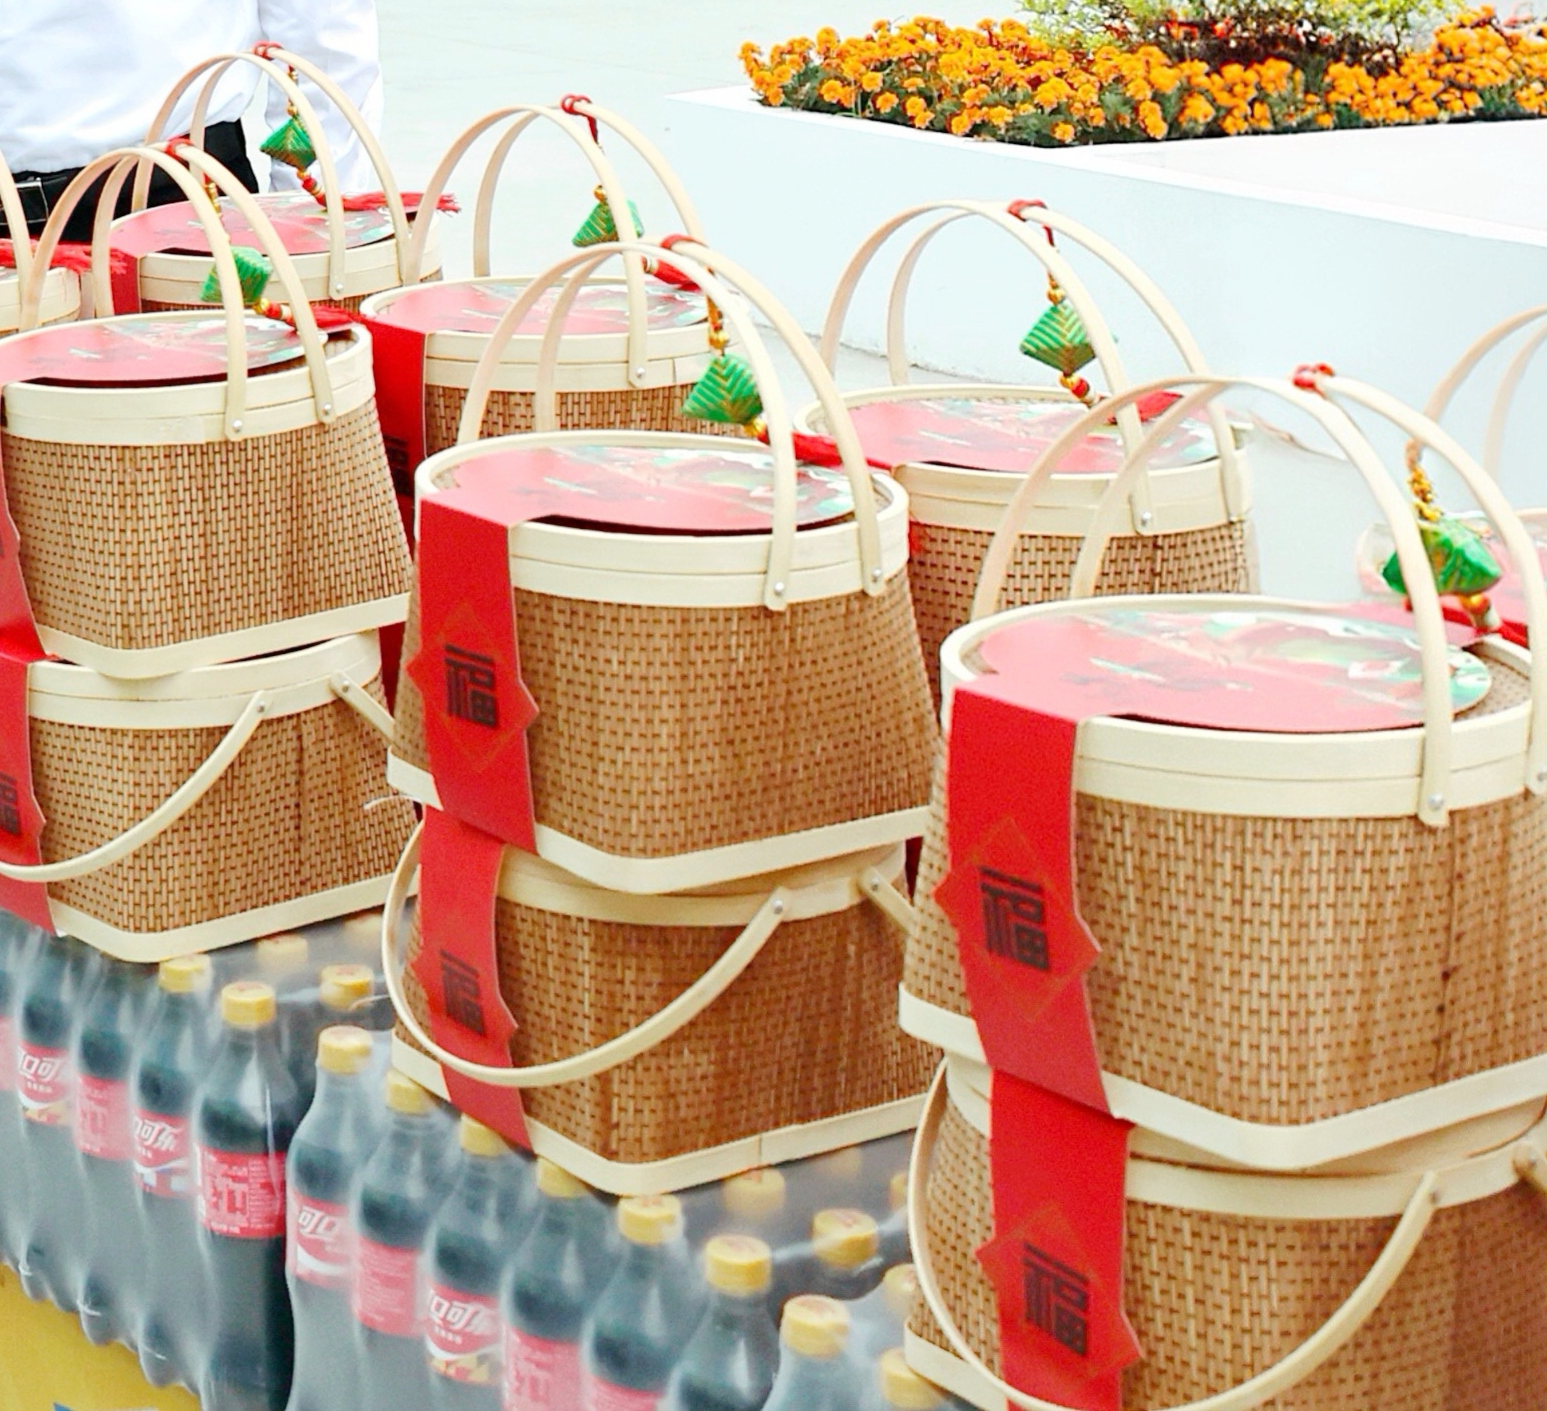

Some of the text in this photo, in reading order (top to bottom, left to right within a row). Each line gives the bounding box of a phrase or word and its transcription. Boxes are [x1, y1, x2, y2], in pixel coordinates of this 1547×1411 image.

[444, 643, 497, 727] 福
[981, 866, 1049, 970] 福
[440, 949, 484, 1035] 福
[1023, 1243, 1087, 1357] 福
